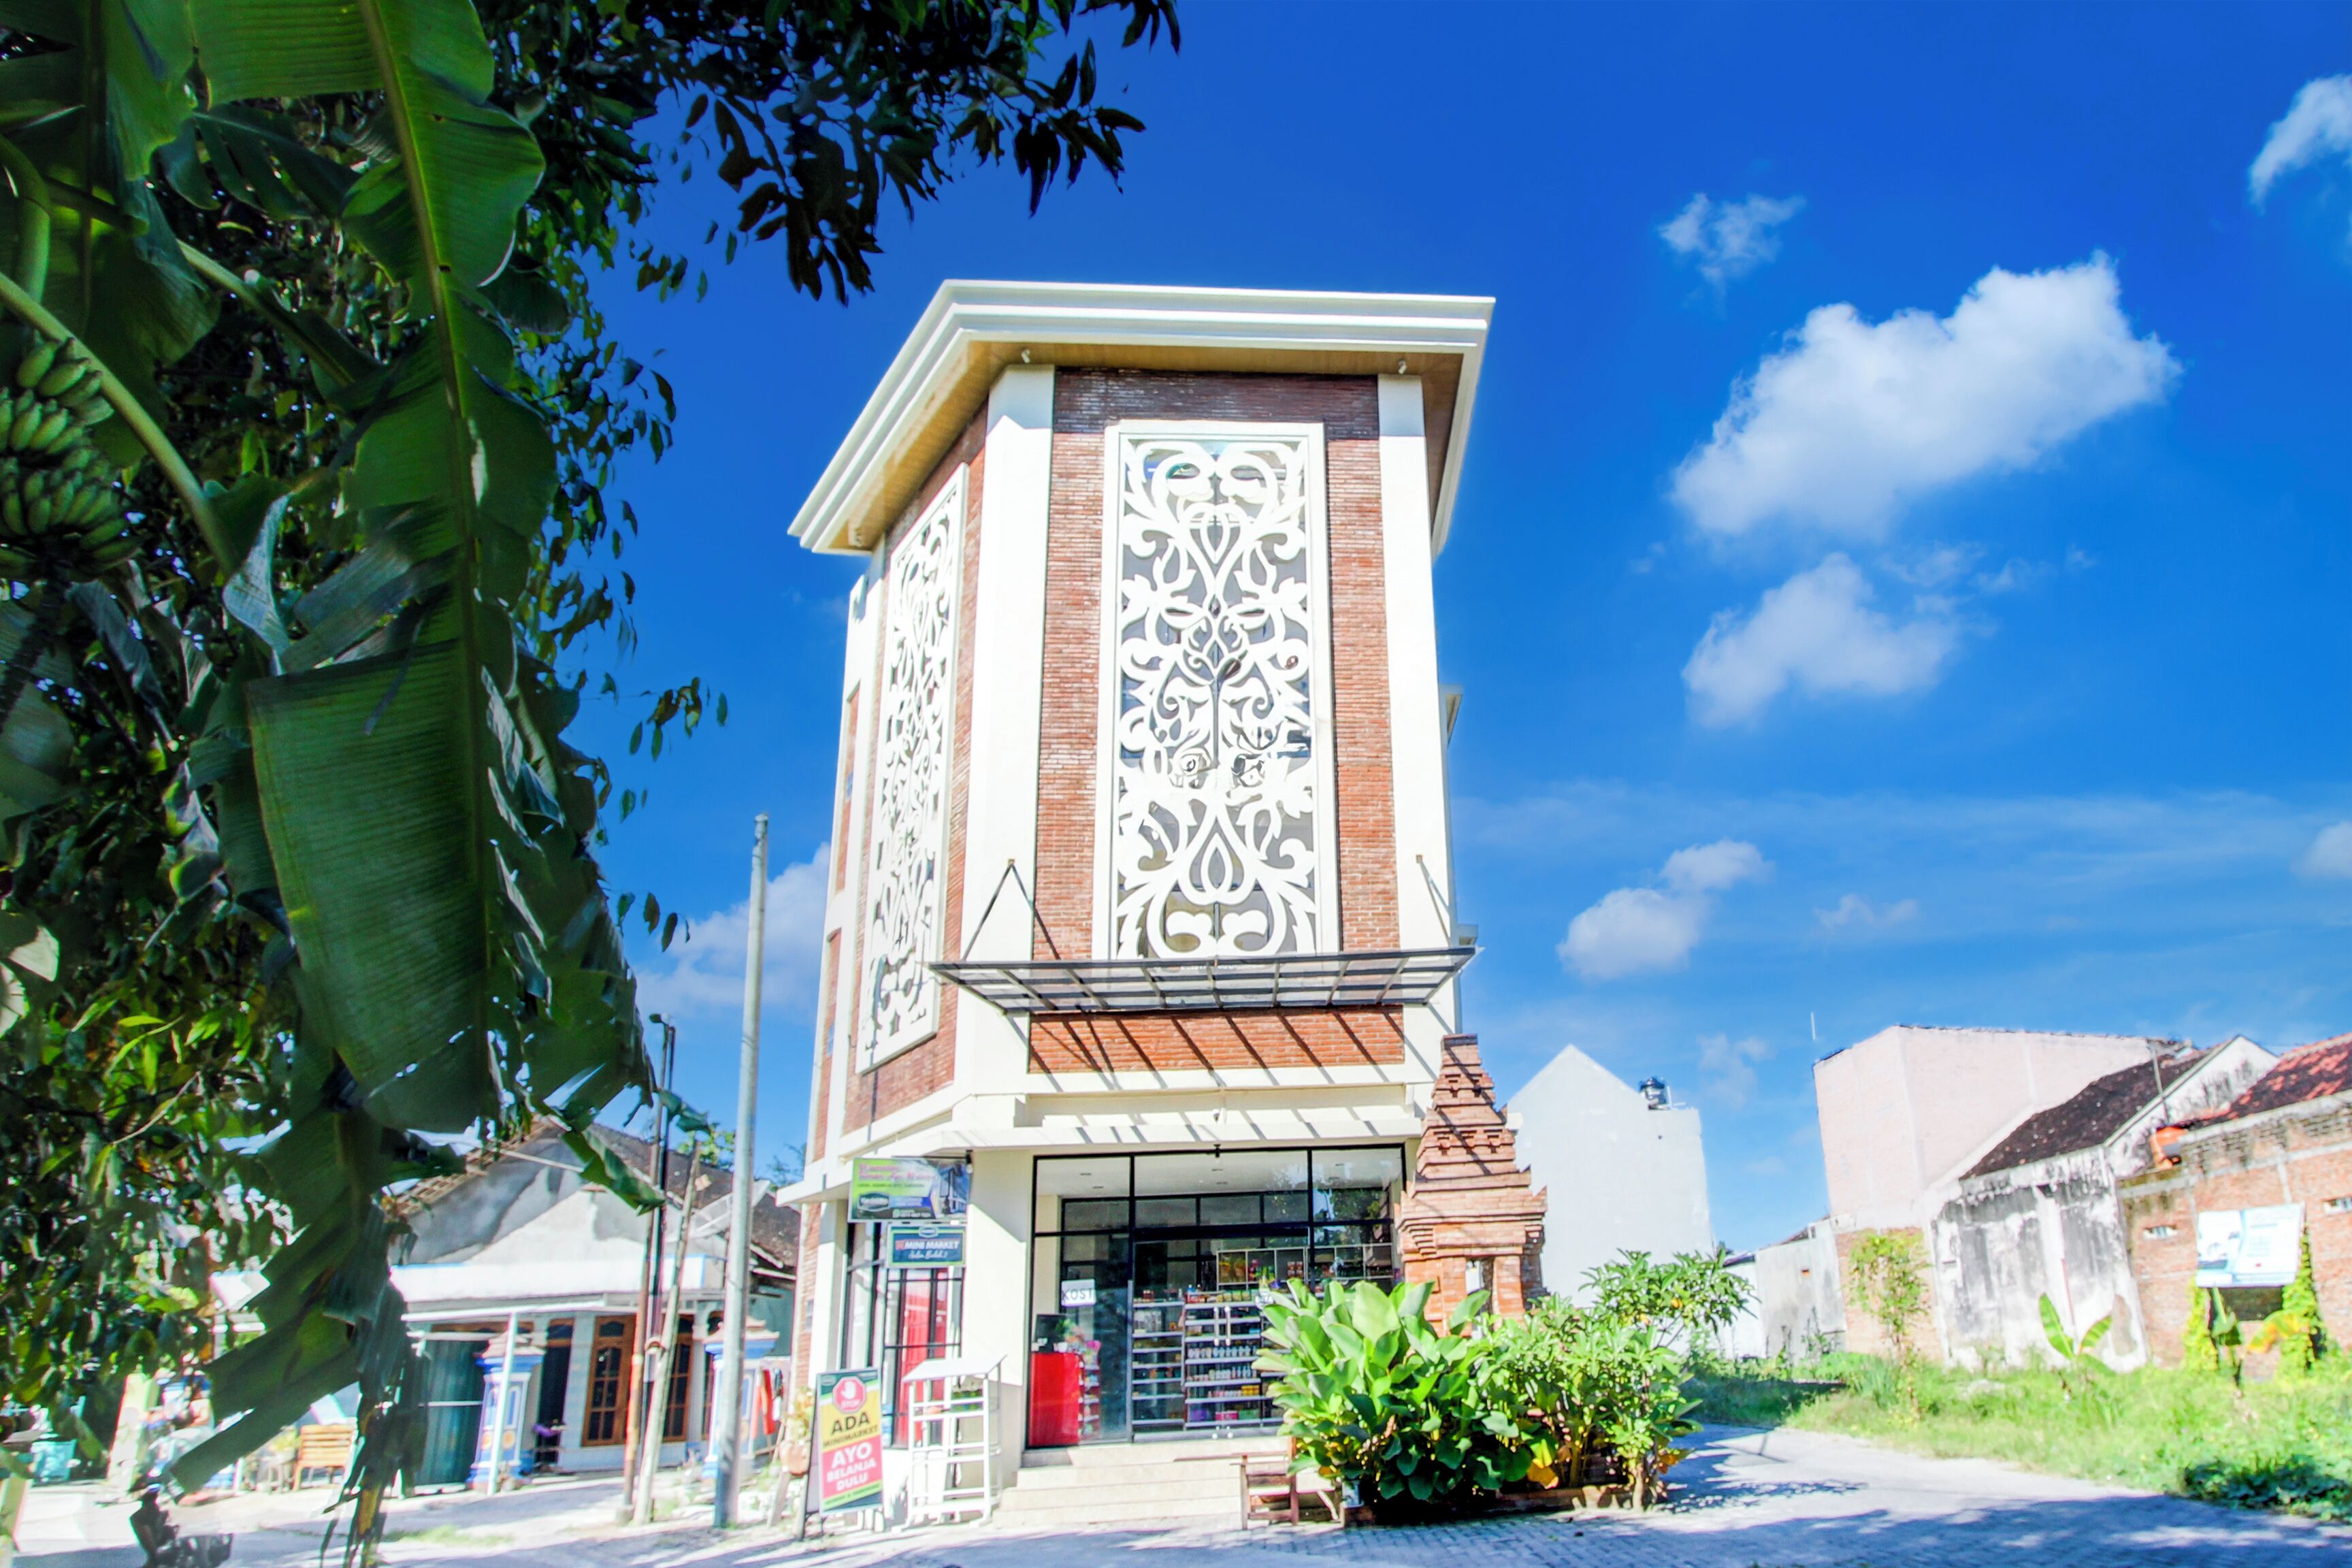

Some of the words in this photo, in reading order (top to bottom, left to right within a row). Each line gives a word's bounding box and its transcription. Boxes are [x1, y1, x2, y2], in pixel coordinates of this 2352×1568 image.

[904, 1241, 925, 1250] MINI
[926, 1240, 960, 1250] MARKET
[1062, 1288, 1093, 1301] KOST
[840, 1399, 860, 1407] STOP
[832, 1412, 870, 1435] ADA
[823, 1425, 878, 1446] MINIMARKET
[832, 1442, 872, 1469] AYO
[827, 1458, 877, 1483] BELANJA
[836, 1471, 868, 1492] DULU
